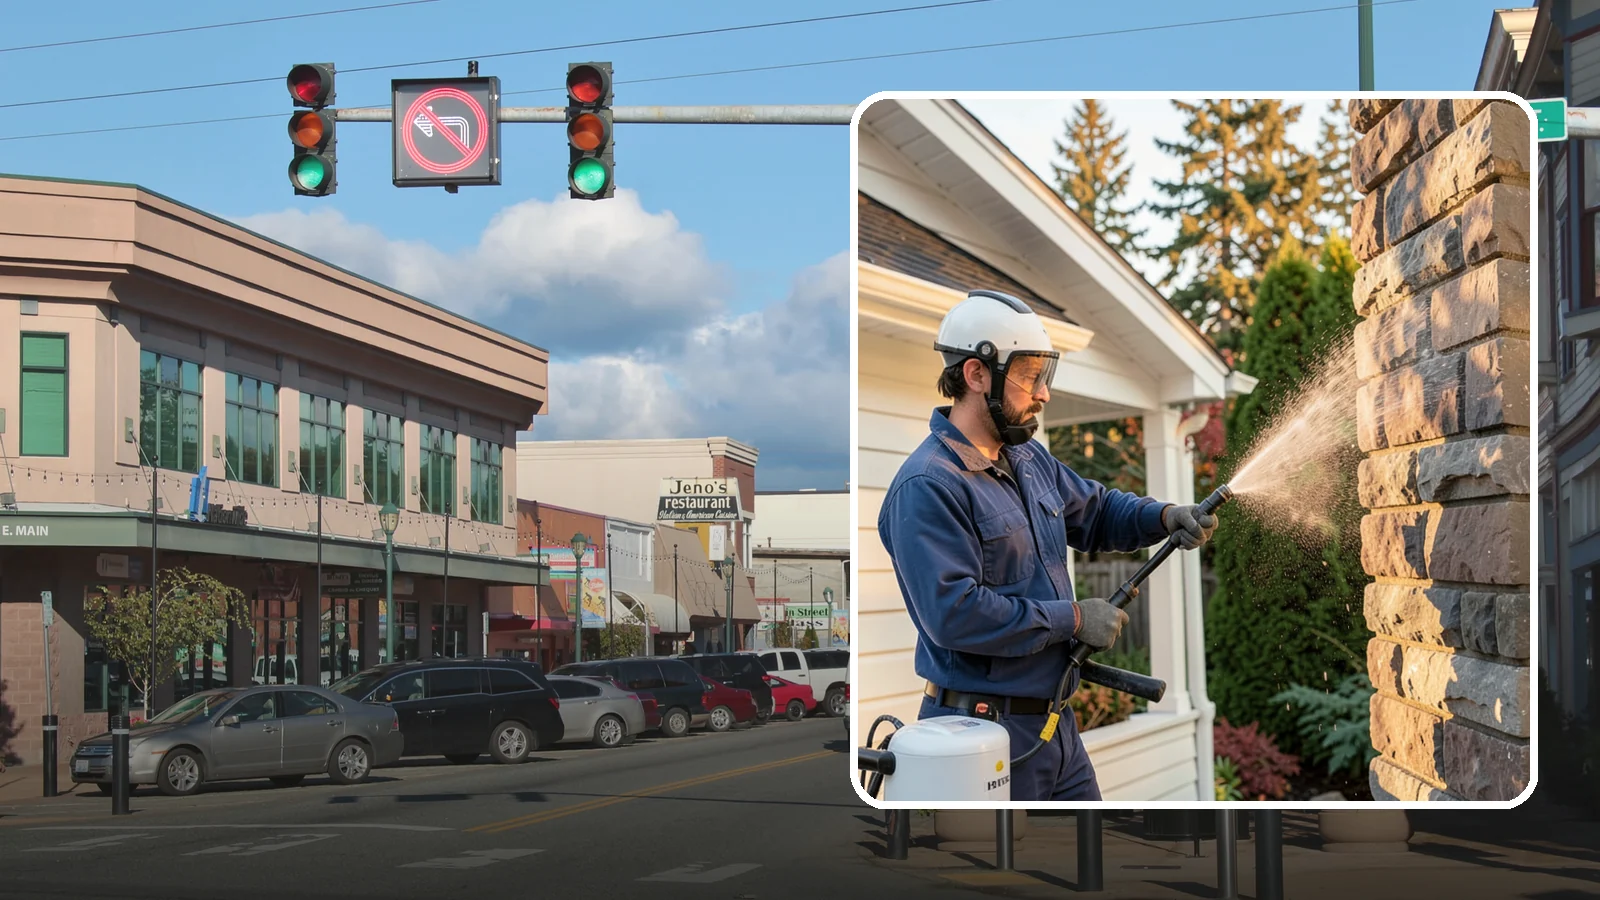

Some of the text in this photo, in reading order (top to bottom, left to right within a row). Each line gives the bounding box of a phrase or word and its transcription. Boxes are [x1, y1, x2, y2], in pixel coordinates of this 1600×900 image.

[670, 480, 727, 494] Jeno's
[665, 497, 731, 509] restaurant
[659, 509, 682, 520] Italian
[686, 509, 715, 520] American
[715, 509, 737, 519] Cuisine
[2, 525, 49, 536] E. MAIN
[797, 608, 828, 616] Street
